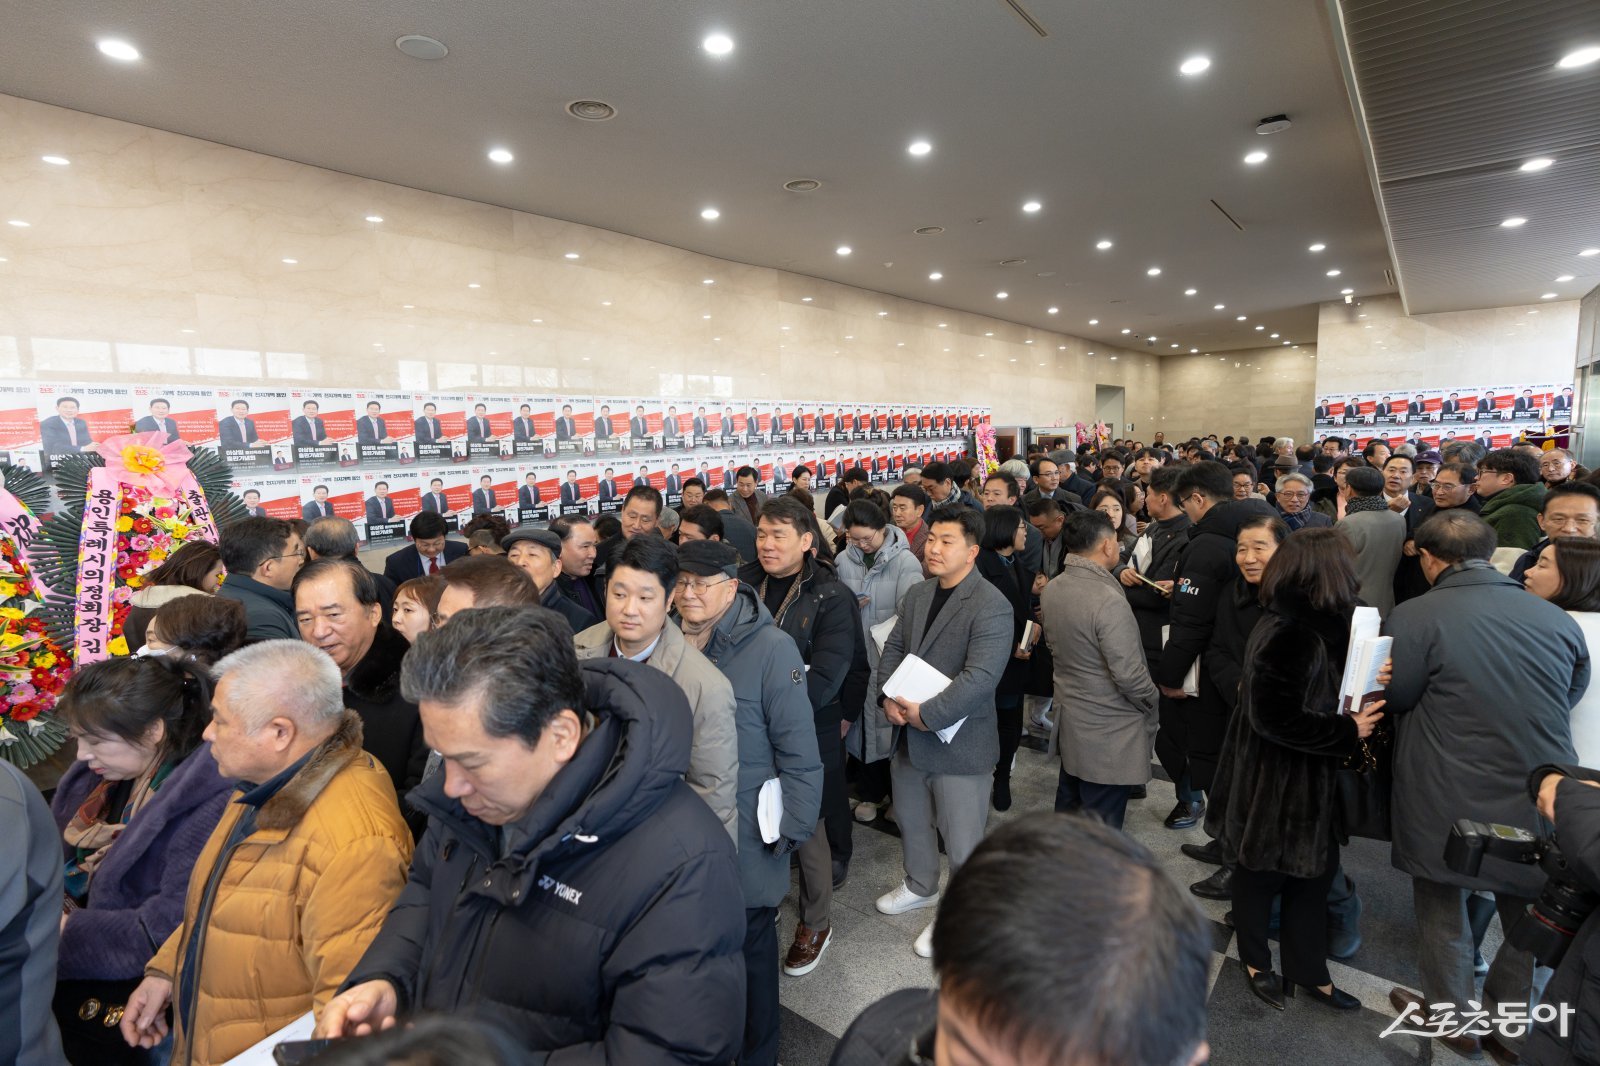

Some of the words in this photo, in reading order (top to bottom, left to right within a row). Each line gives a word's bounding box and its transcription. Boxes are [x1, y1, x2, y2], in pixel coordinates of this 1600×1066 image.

[188, 490, 218, 546] 출판기
[80, 490, 115, 632] 용인특례시의정회장
[554, 882, 582, 905] YONEX
